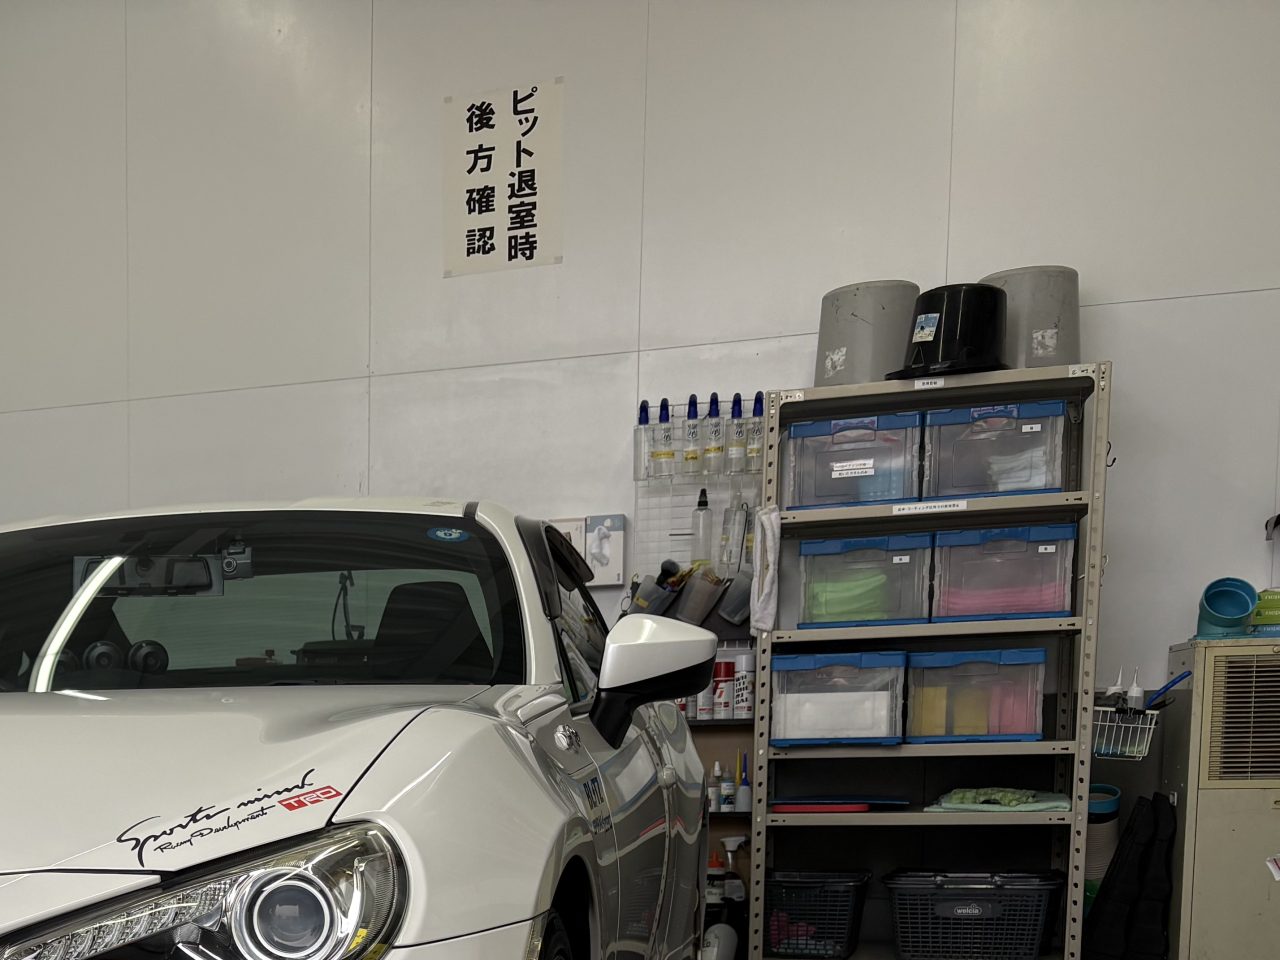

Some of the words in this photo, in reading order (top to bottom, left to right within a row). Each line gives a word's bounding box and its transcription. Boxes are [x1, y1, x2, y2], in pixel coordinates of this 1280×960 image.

[465, 101, 496, 258] 後方確認
[507, 86, 539, 262] ピット退室時
[116, 805, 231, 868] Sports
[236, 768, 316, 809] mind
[153, 836, 196, 854] Racing
[190, 804, 277, 839] Development
[280, 787, 339, 809] TRD
[956, 904, 980, 914] welcia
